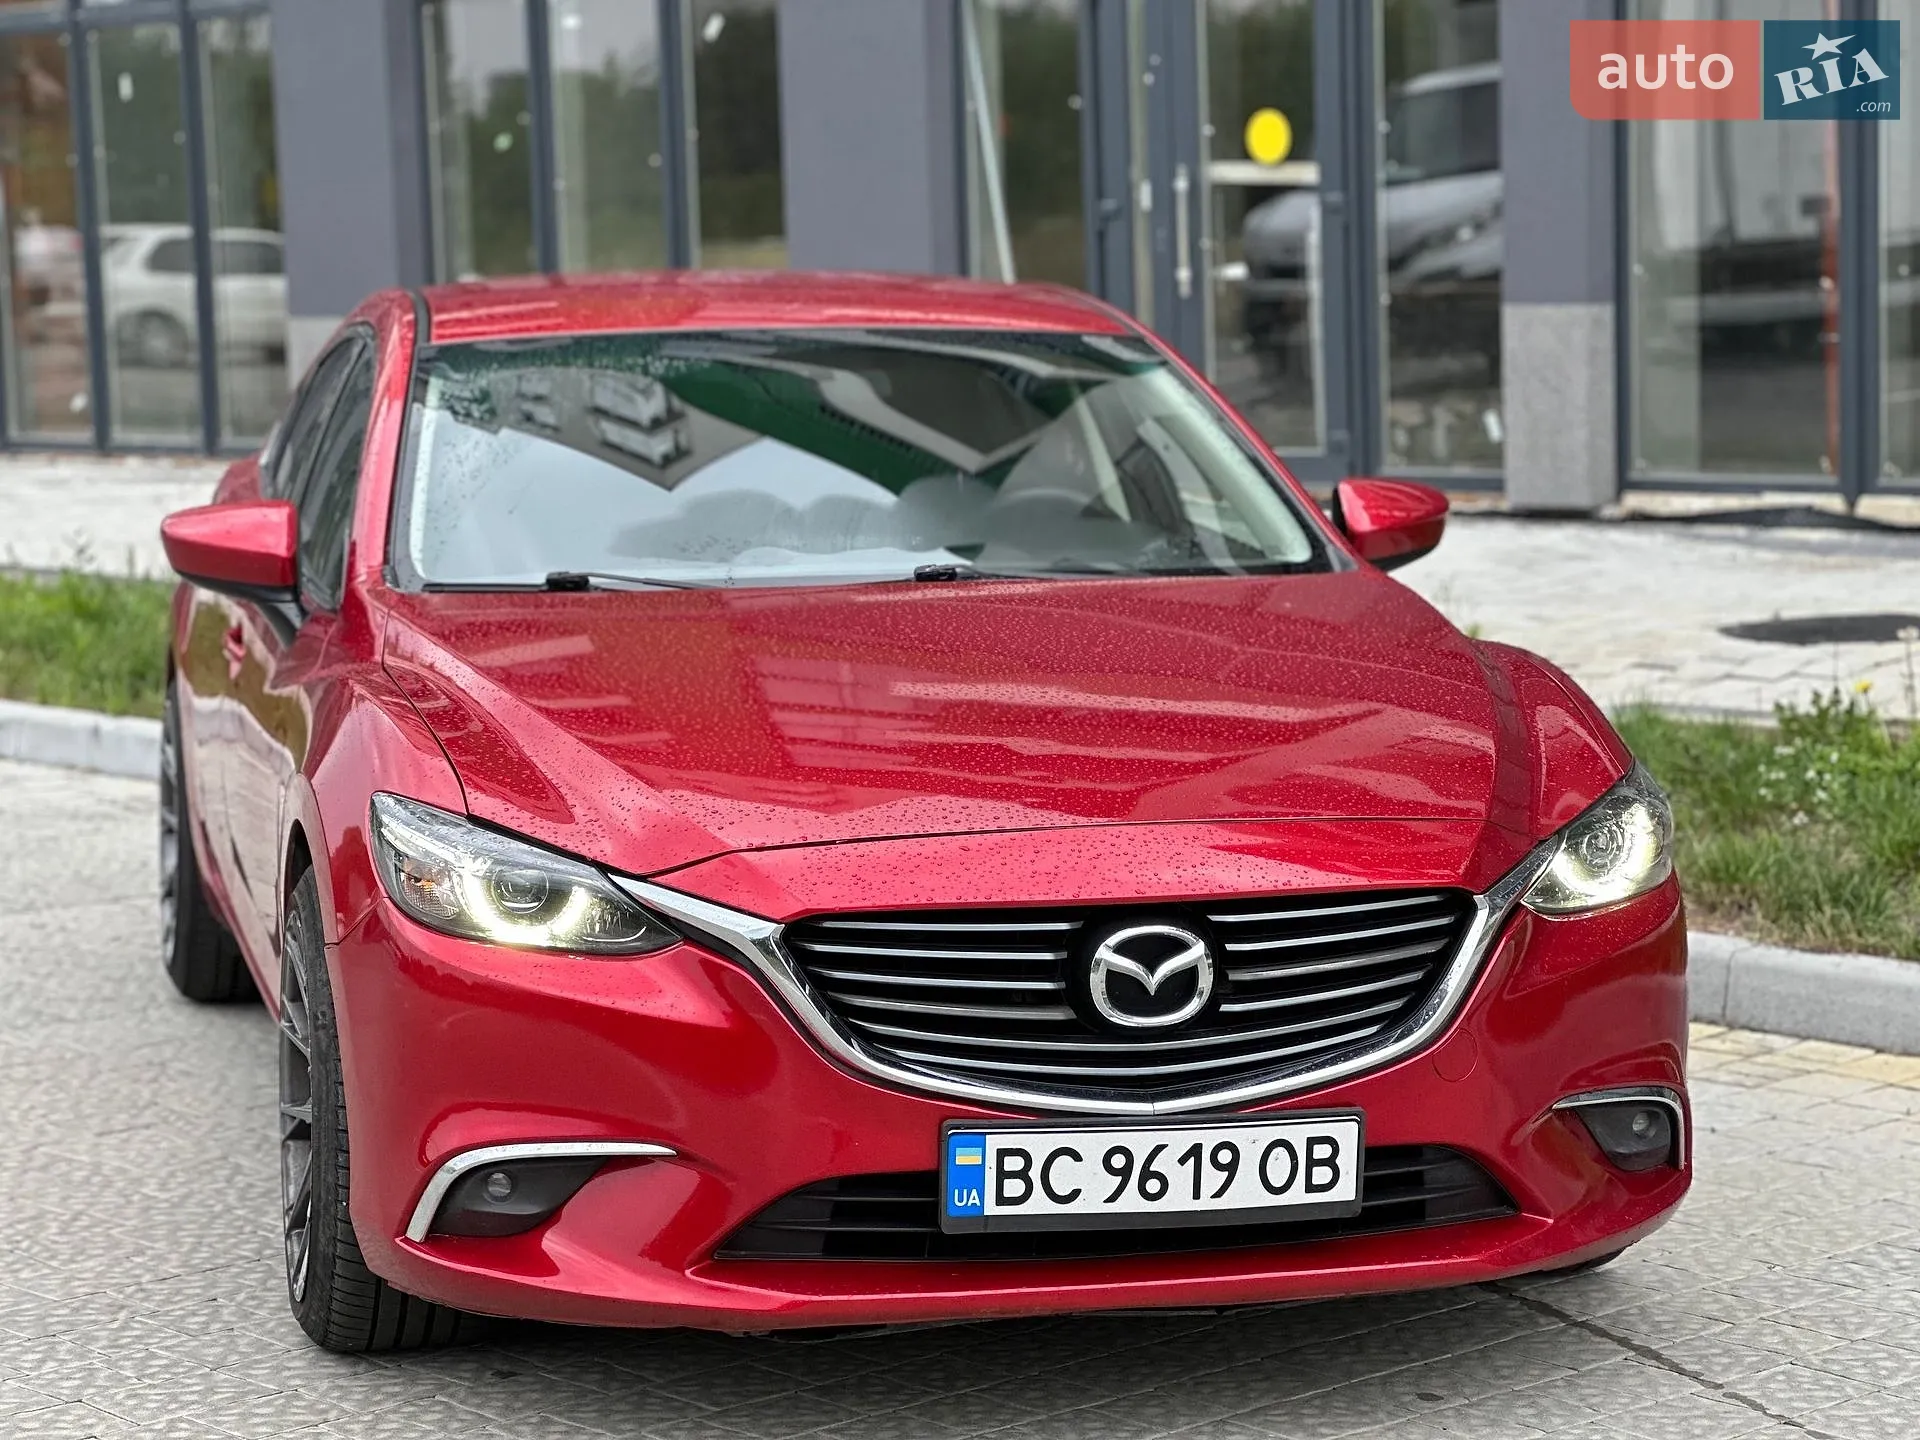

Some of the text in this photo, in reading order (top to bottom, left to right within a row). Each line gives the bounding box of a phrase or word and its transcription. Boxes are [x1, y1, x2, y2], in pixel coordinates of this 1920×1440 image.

[996, 1135, 1341, 1207] BC 9619 OB
[954, 1189, 980, 1206] UA
